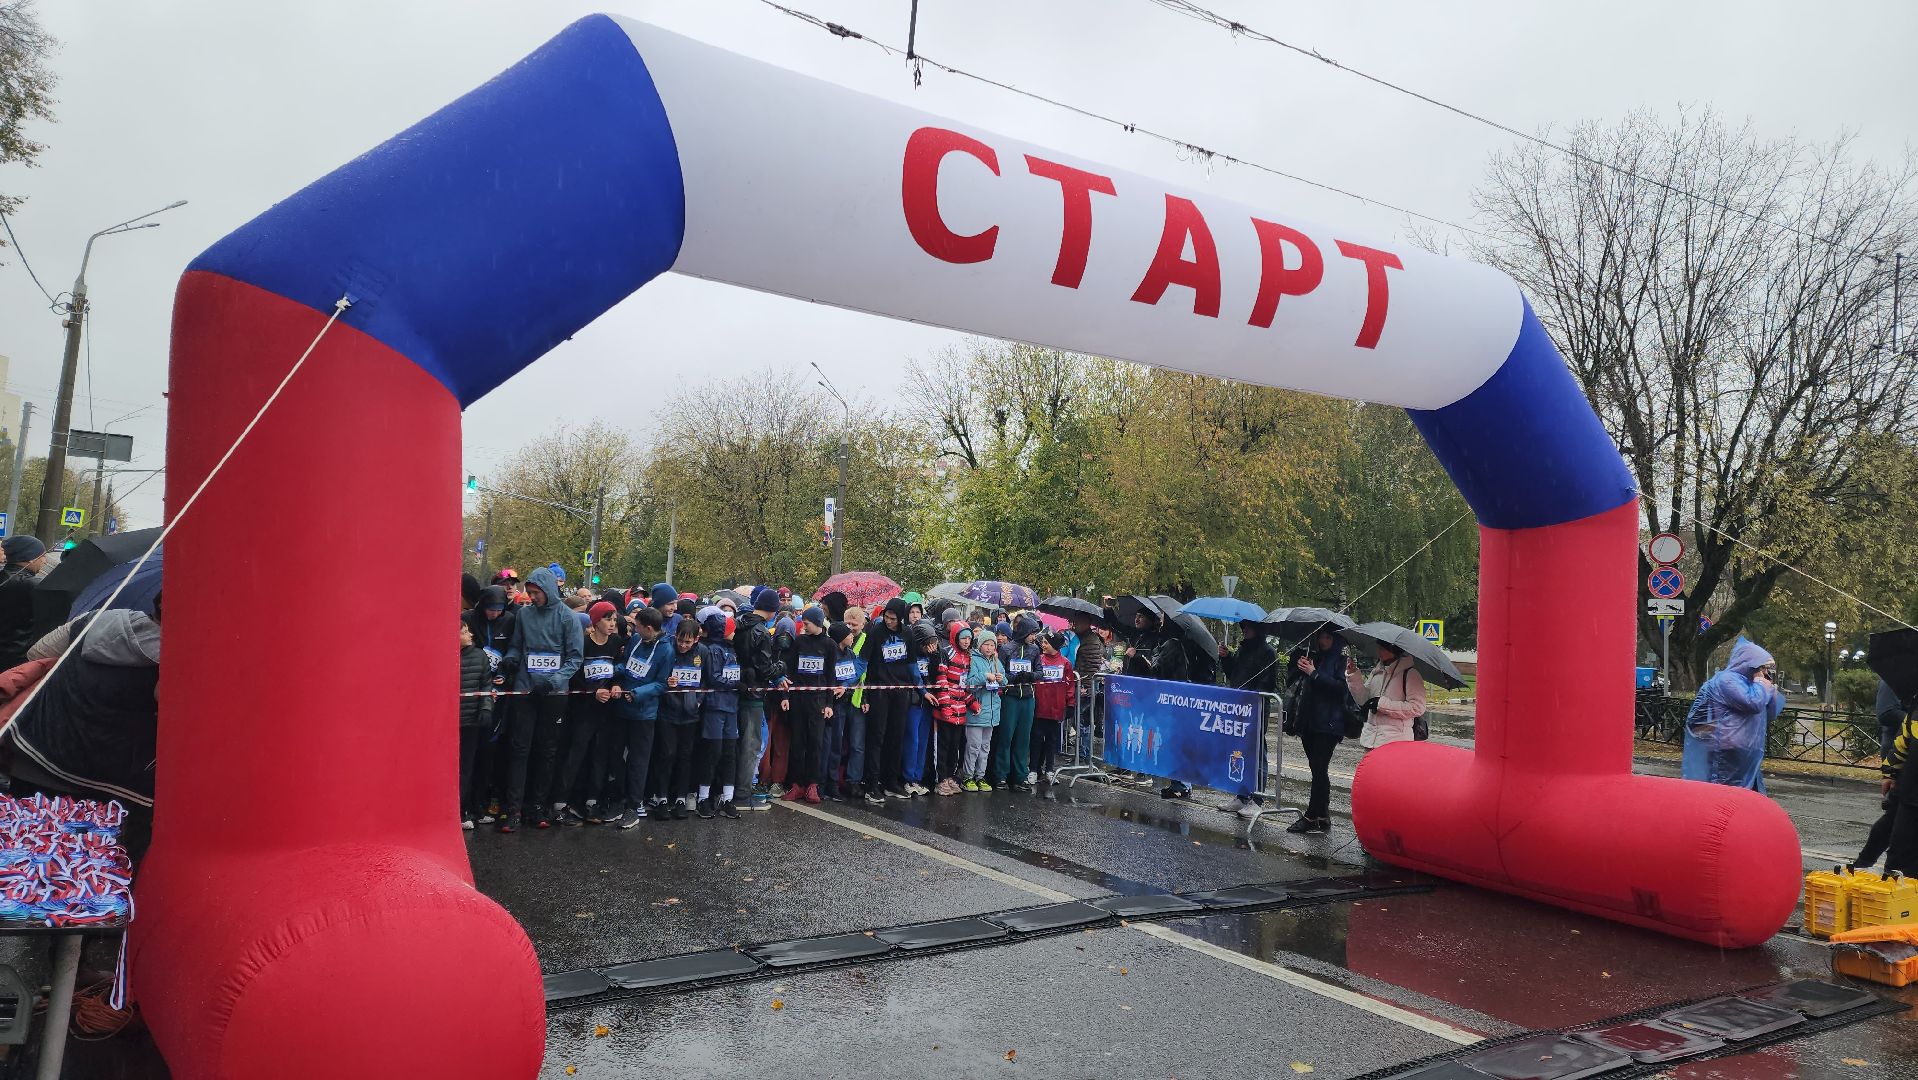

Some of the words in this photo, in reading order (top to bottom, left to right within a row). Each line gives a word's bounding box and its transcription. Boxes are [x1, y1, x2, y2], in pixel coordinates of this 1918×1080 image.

[902, 126, 1405, 350] СТАРТ
[531, 658, 557, 668] 1556
[801, 660, 820, 670] 1231
[586, 666, 610, 676] 1236
[675, 671, 698, 681] 1234
[1157, 693, 1253, 717] ЛЕГКОАТЛЕТИЧЕСКИЙ
